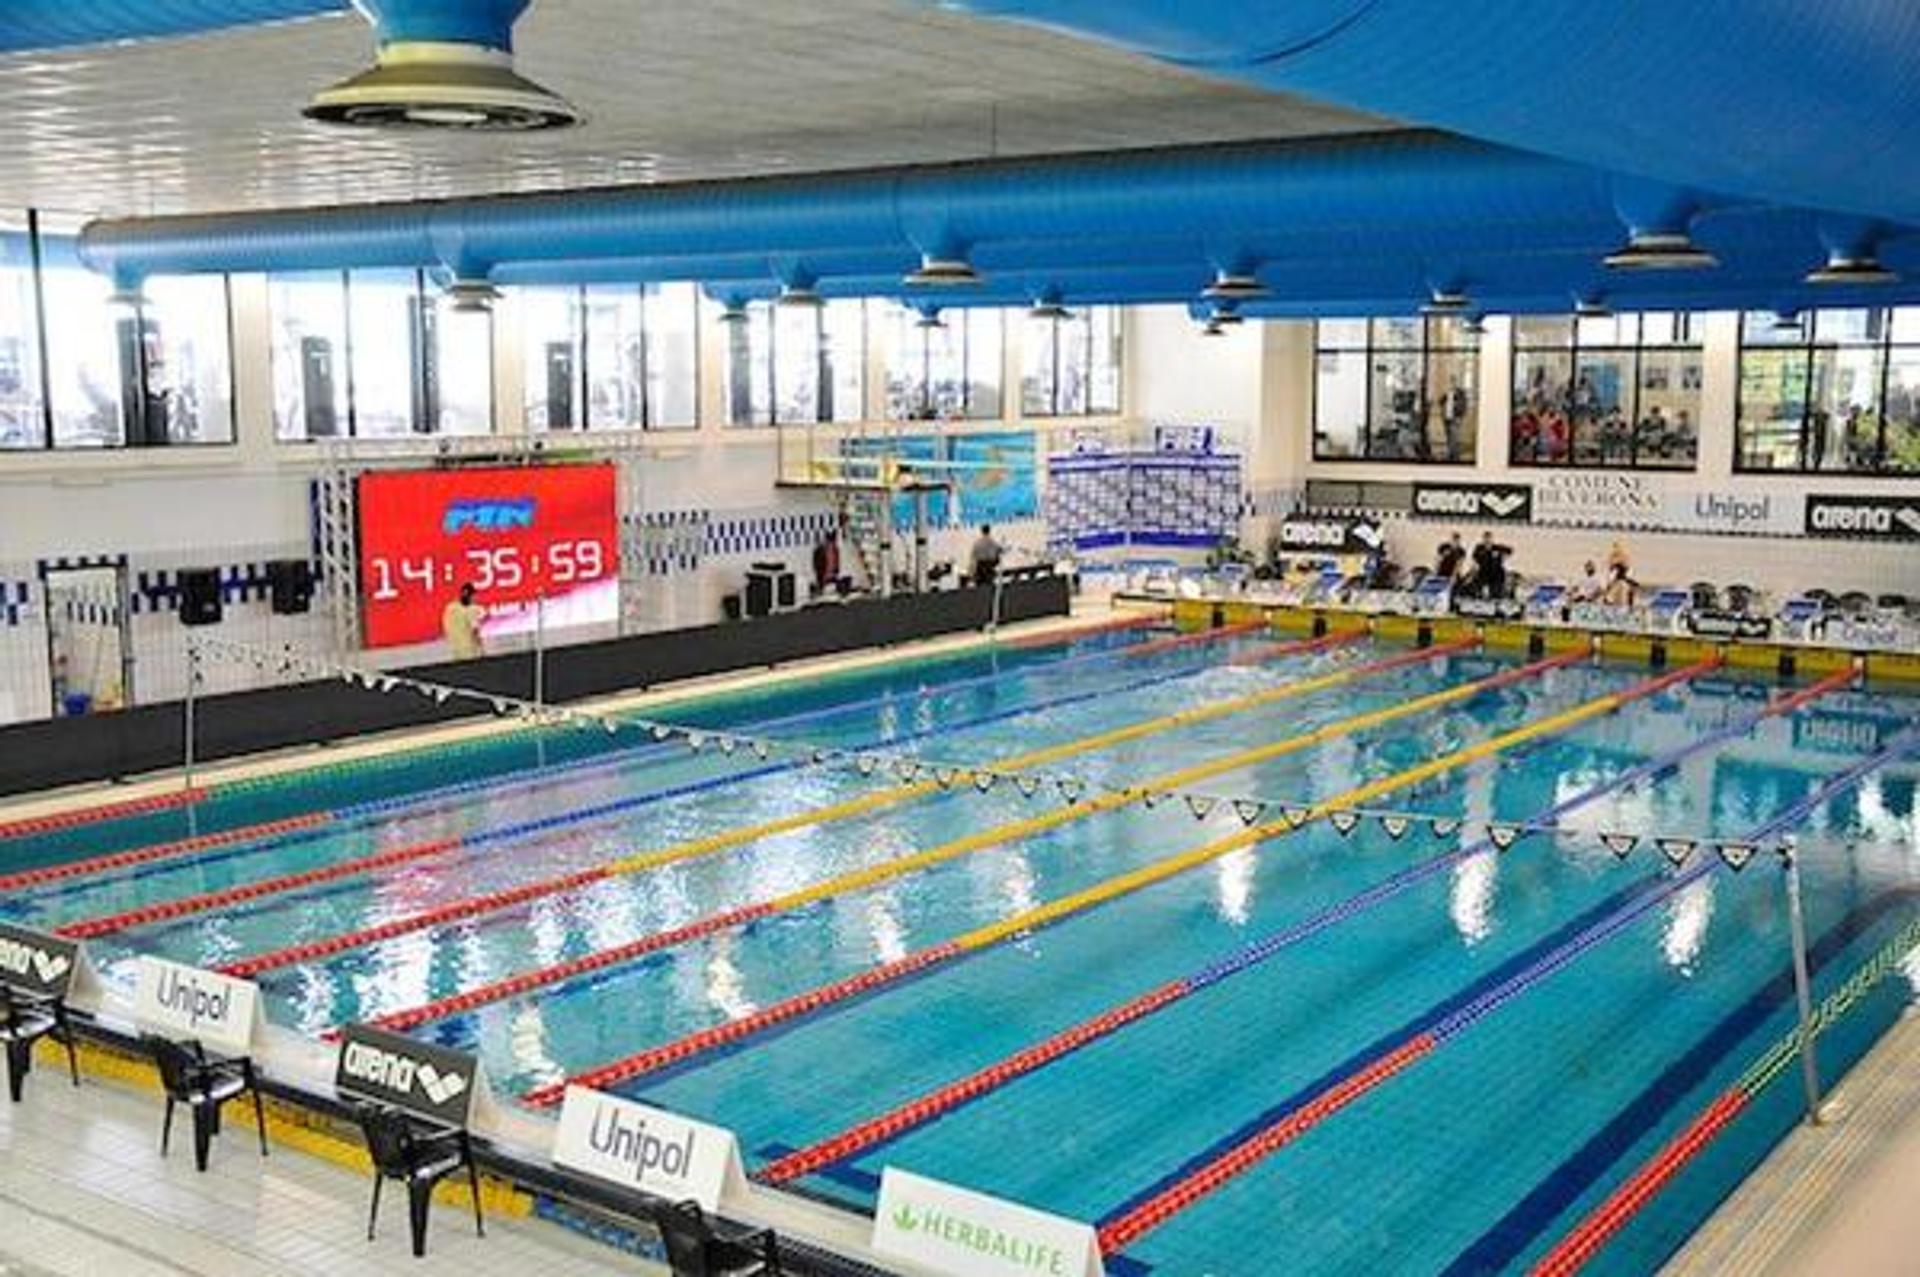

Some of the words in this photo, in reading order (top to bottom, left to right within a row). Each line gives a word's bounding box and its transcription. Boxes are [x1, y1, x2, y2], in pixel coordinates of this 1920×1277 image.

[1417, 489, 1479, 514] arena
[1696, 495, 1770, 526] Unipol
[1812, 504, 1892, 532] arena
[156, 965, 232, 1029] Unipol
[344, 1040, 416, 1094] arena
[588, 1107, 693, 1180] Unipol
[919, 1211, 1066, 1275] HERBALIFE
